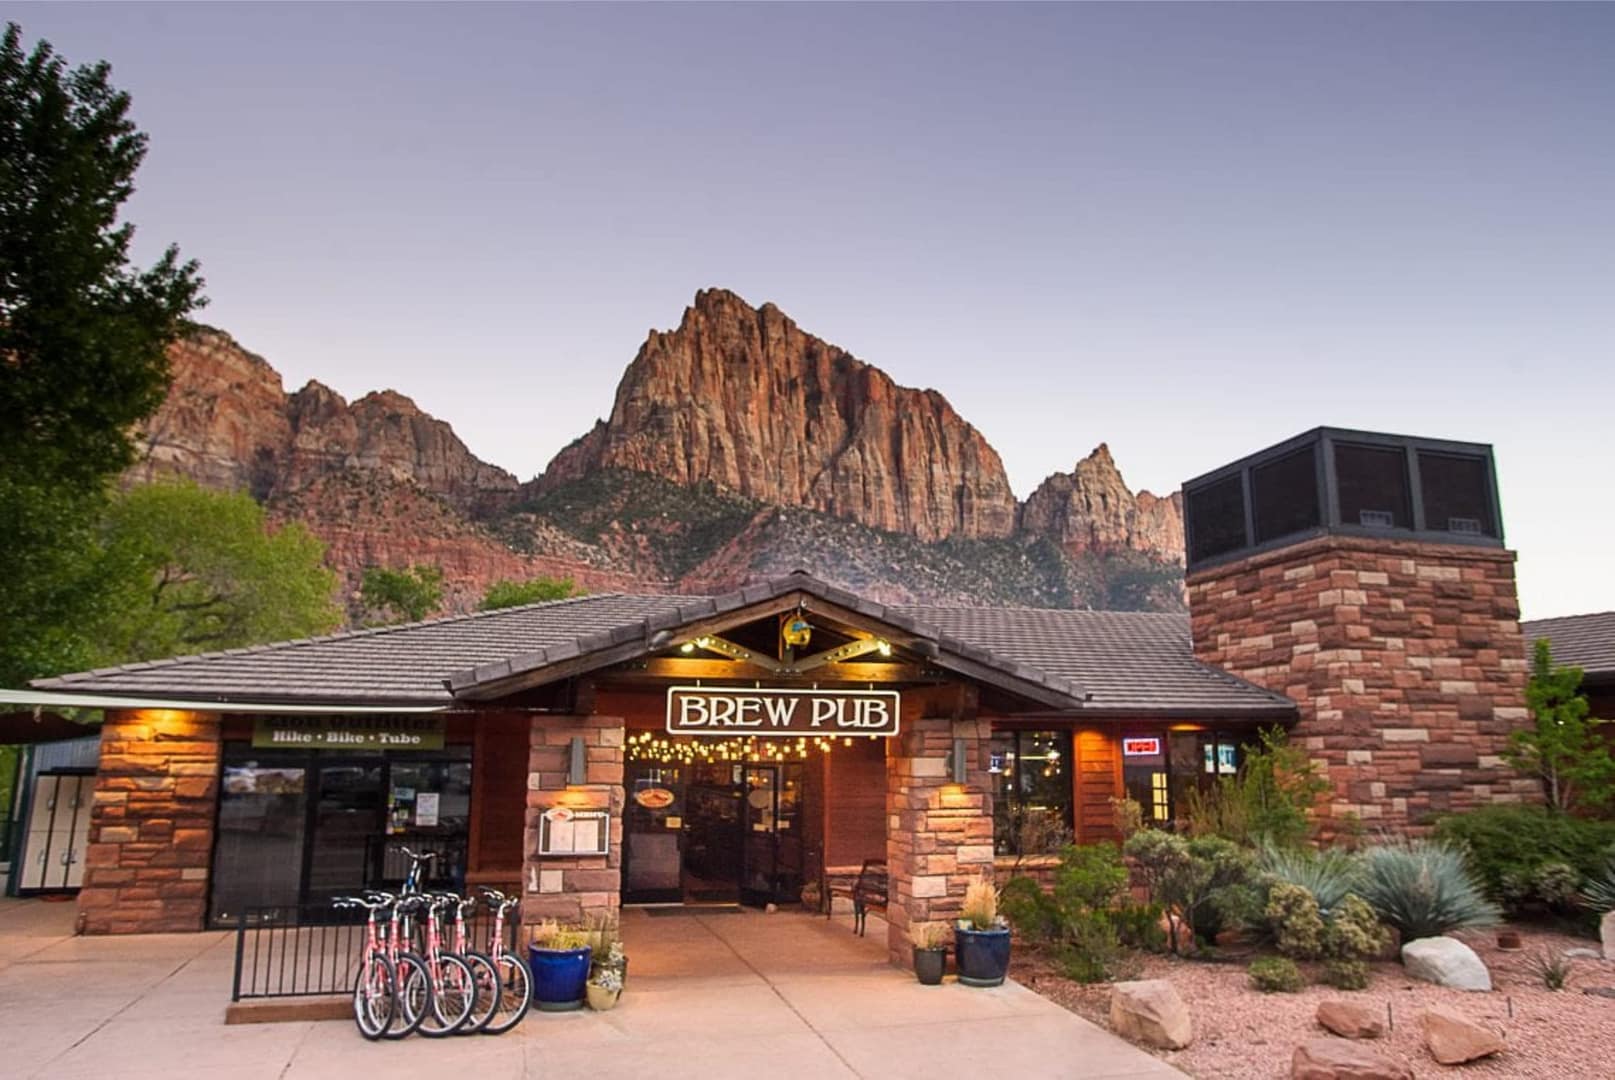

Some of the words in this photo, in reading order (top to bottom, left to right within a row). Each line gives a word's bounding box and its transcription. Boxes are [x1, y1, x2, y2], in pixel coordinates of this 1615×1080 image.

[679, 695, 799, 727] BREW
[810, 698, 890, 728] PUB
[272, 730, 312, 743] Hike
[326, 731, 365, 744] Bike
[379, 732, 421, 745] Tube
